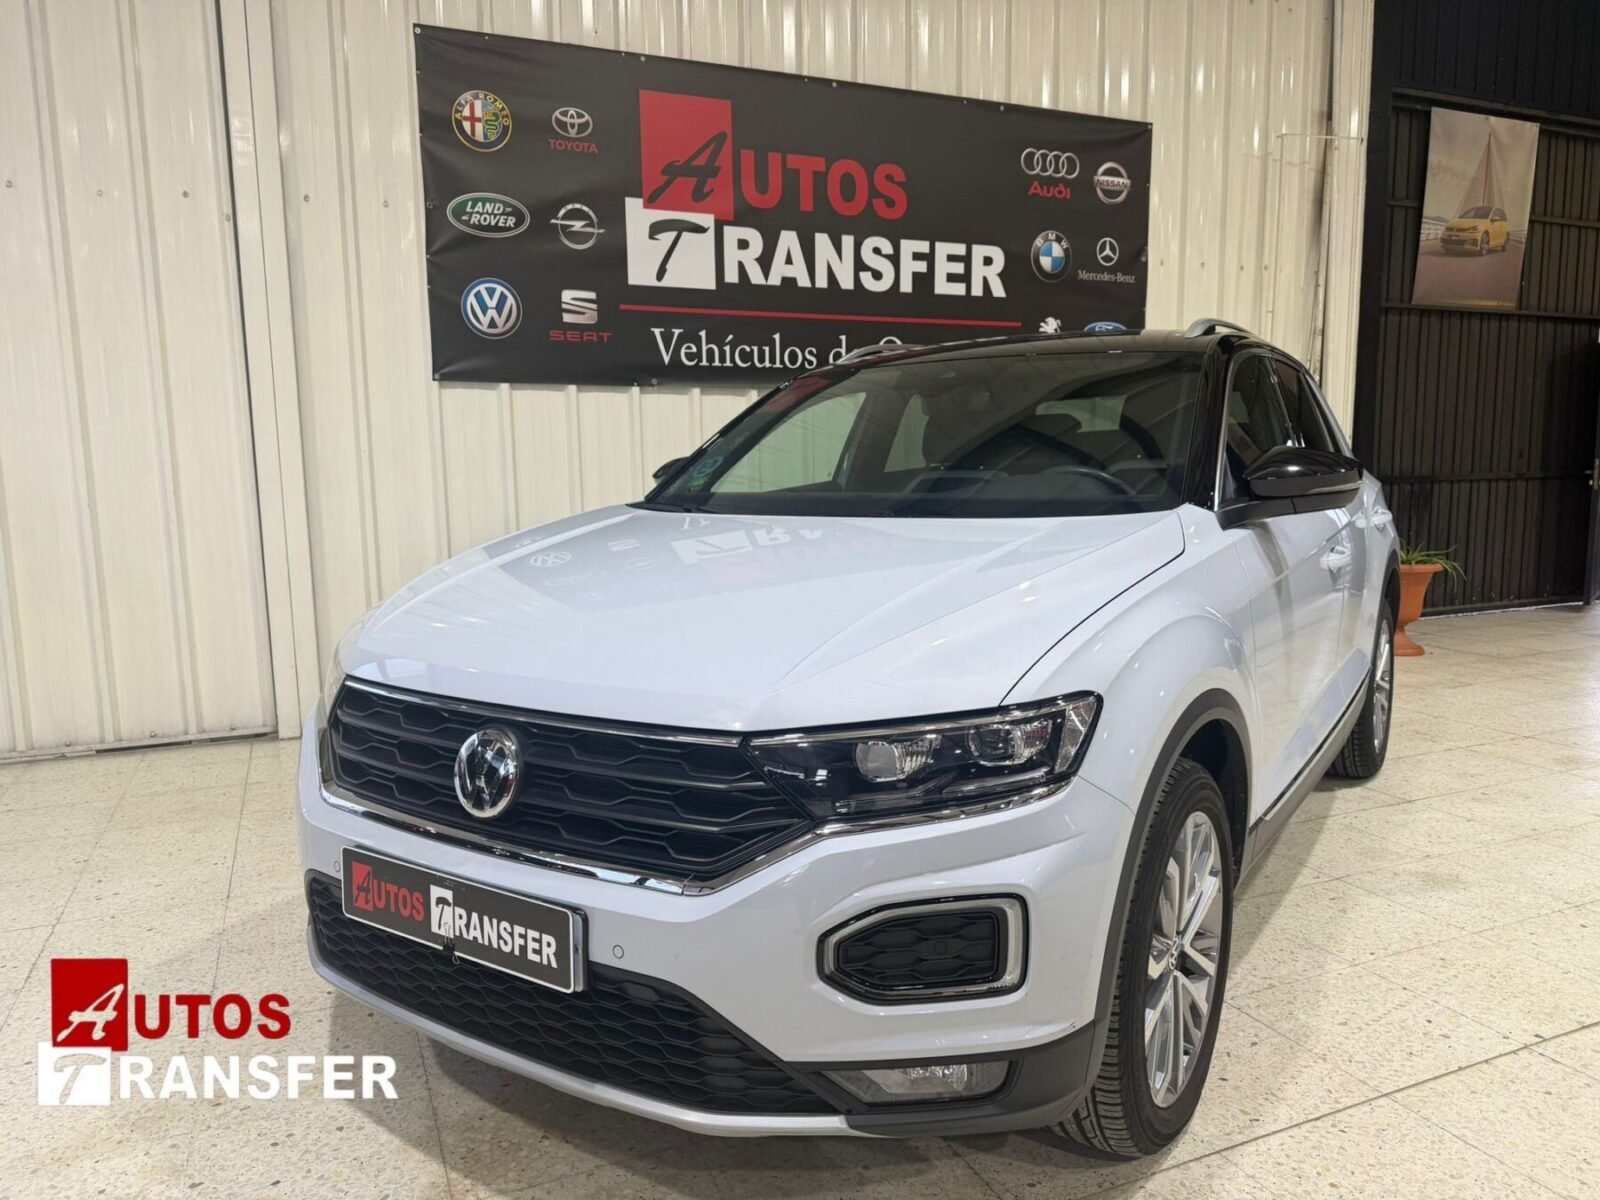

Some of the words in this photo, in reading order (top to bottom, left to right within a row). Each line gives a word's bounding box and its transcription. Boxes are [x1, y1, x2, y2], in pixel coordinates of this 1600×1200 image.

[454, 93, 474, 120] ALFA
[478, 92, 510, 127] ROMEO
[548, 139, 599, 154] TOYOTA
[646, 131, 908, 220] AUTOS
[1096, 177, 1129, 189] NISSAN
[1028, 180, 1072, 199] Audi
[466, 201, 504, 214] LAND
[470, 214, 517, 228] ROVER
[648, 218, 1007, 298] TRANSFER
[1078, 269, 1136, 283] Mercedes-Benz
[549, 330, 612, 343] SEAT
[650, 327, 817, 369] Vehículos
[828, 334, 861, 365] d
[353, 872, 425, 923] AUTOS
[435, 896, 558, 969] TRANSFER
